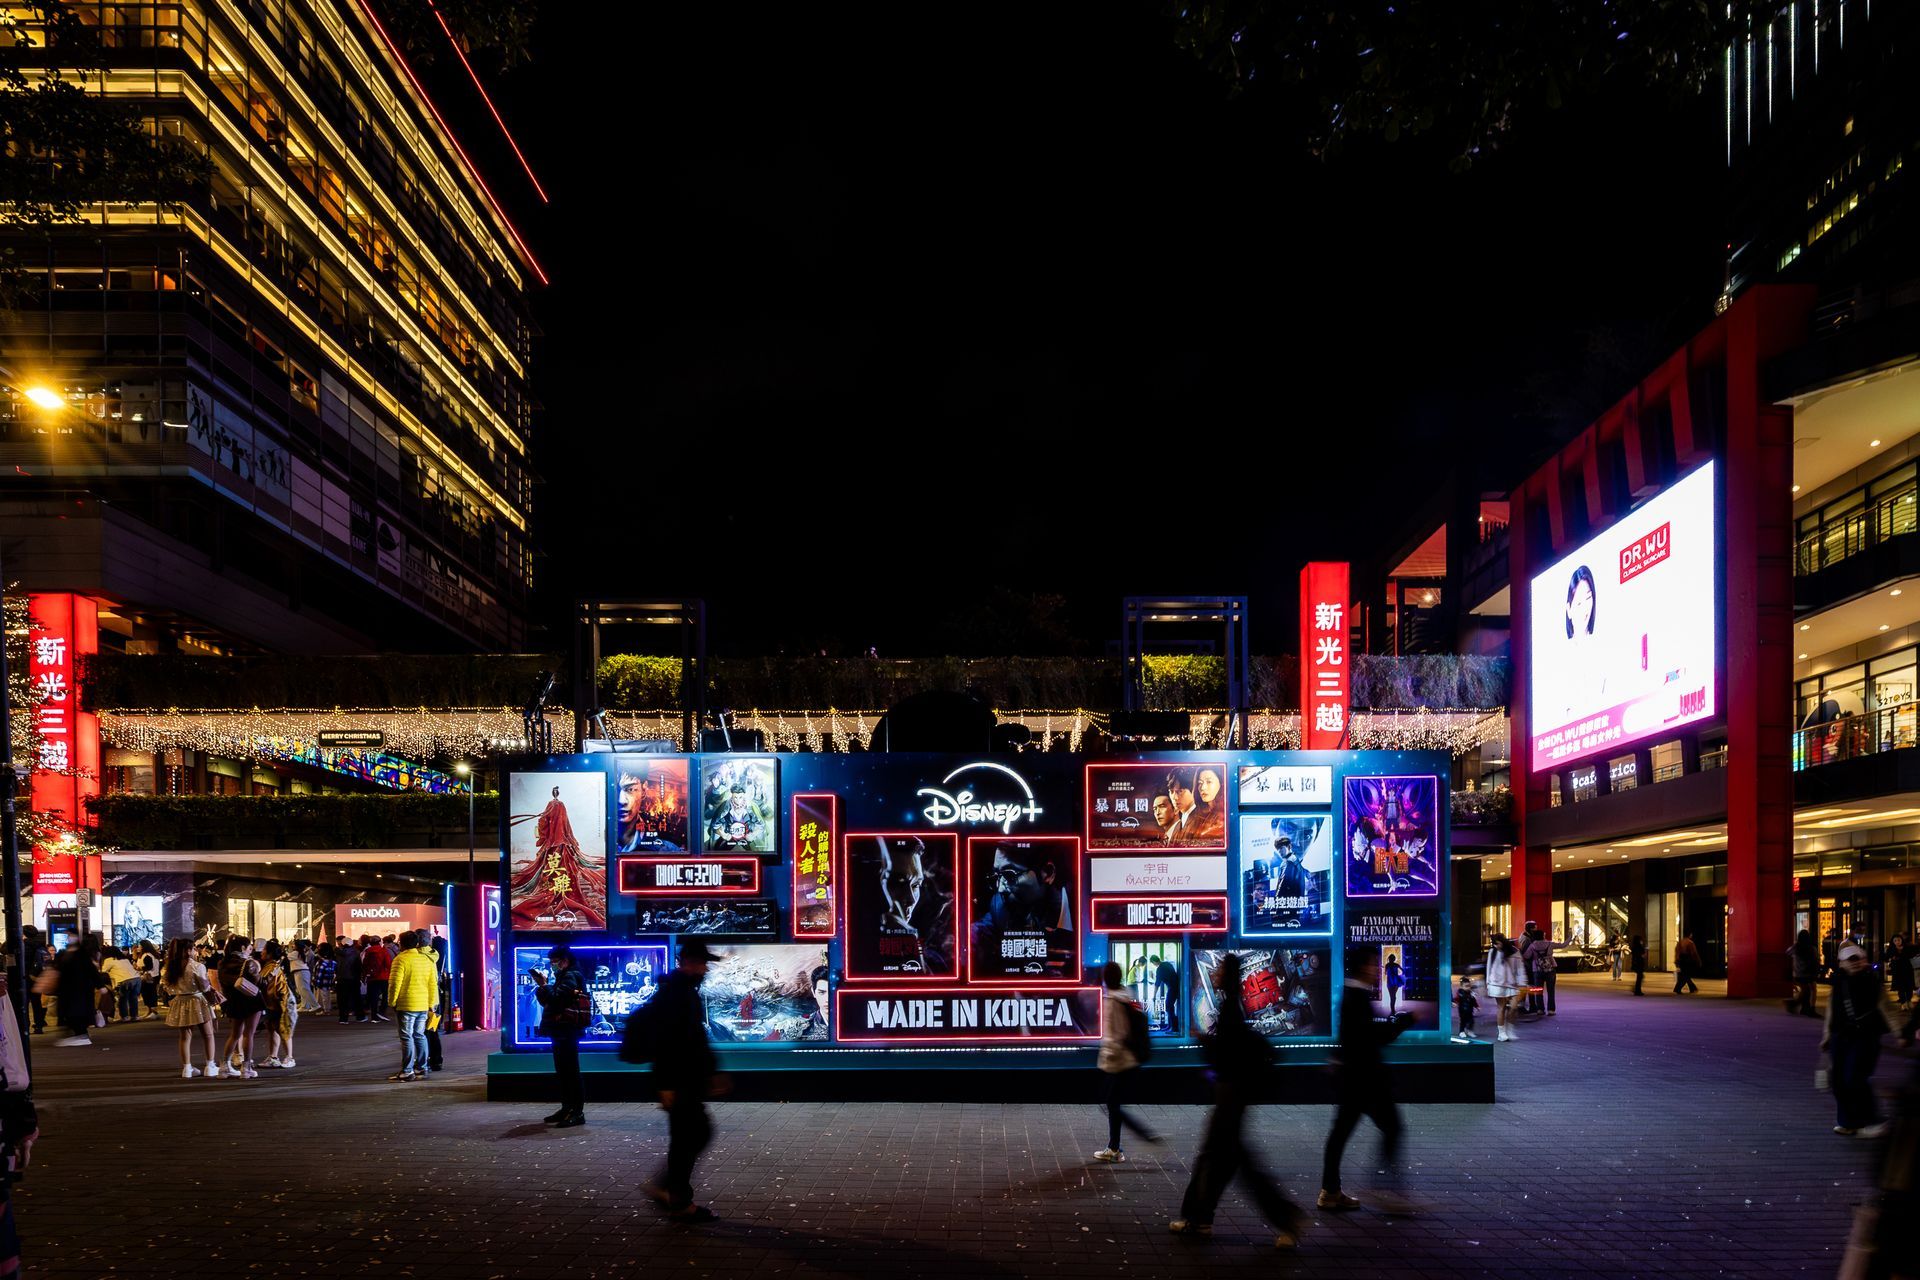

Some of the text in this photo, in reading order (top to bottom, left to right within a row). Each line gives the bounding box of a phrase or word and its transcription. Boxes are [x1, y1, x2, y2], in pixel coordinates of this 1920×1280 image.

[1622, 528, 1667, 569] DR.WU
[1643, 548, 1666, 567] SKINCARE
[1315, 602, 1344, 732] 新光三越
[37, 637, 68, 769] 新光三越
[1256, 777, 1316, 793] 暴風圈
[1578, 771, 1597, 787] caf
[917, 786, 1042, 835] Disney+
[1095, 798, 1149, 813] 暴風圈
[1120, 819, 1140, 829] Disney+
[800, 822, 817, 875] 殺人者
[1144, 863, 1169, 874] 宇宙
[1125, 875, 1164, 886] MARRY
[351, 906, 400, 918] PANDORA
[556, 913, 577, 923] Disney+
[1362, 916, 1420, 926] TAYLOR SWIFT
[1350, 925, 1432, 936] THE END OF AN ERA
[1001, 939, 1047, 958] 韓國製造
[902, 963, 922, 973] Disney+
[1024, 965, 1044, 974] Disney+
[867, 998, 1073, 1028] MADE IN KOREA
[592, 1026, 617, 1037] Disney+
